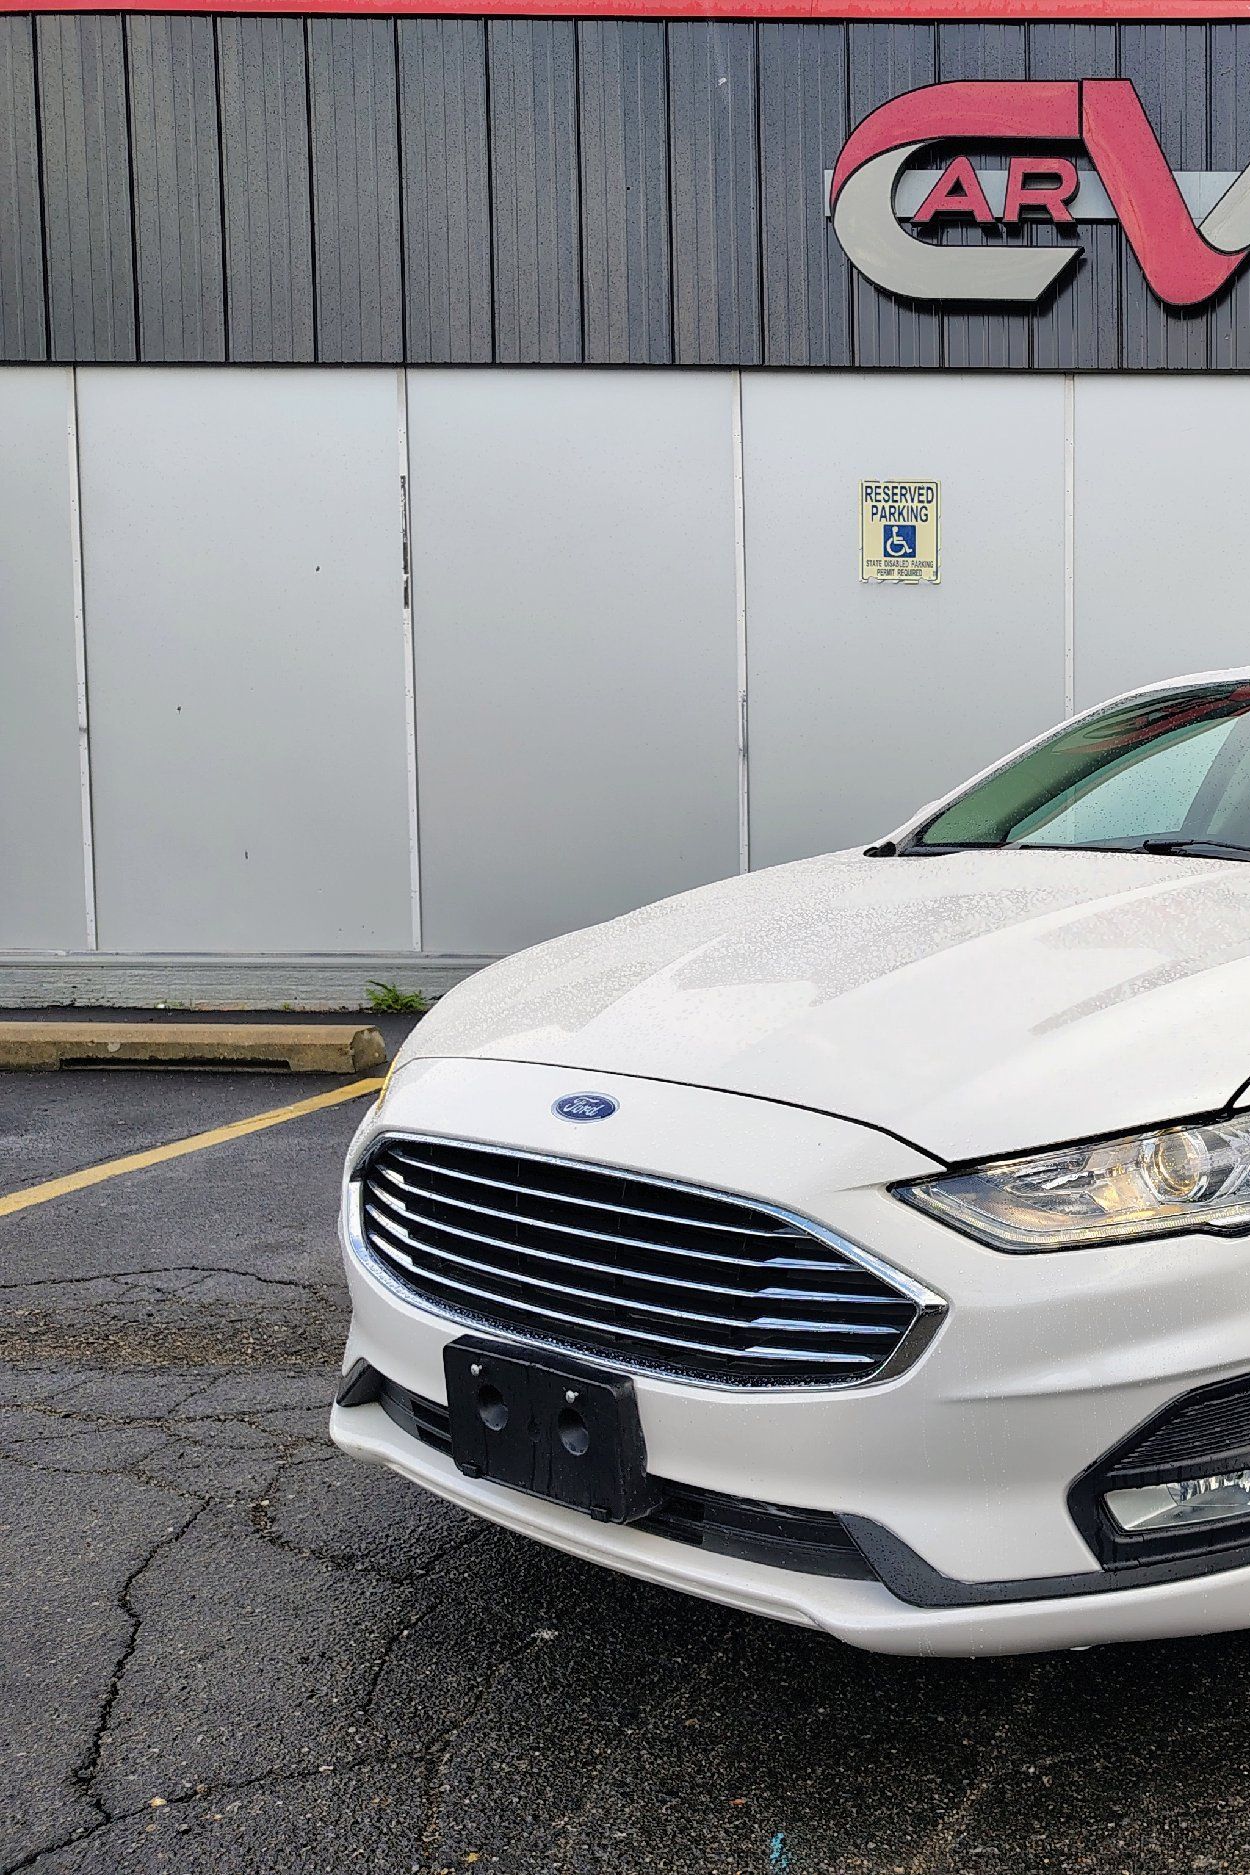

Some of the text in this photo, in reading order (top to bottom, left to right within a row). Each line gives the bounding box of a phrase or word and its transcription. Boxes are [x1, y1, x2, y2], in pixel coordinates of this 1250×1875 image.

[864, 485, 935, 504] RESERVED
[871, 504, 929, 523] PARKING
[866, 559, 934, 569] STATE DISABLED PARKING
[876, 568, 923, 577] PERMIT REQUIRED
[562, 1096, 605, 1117] Ford
